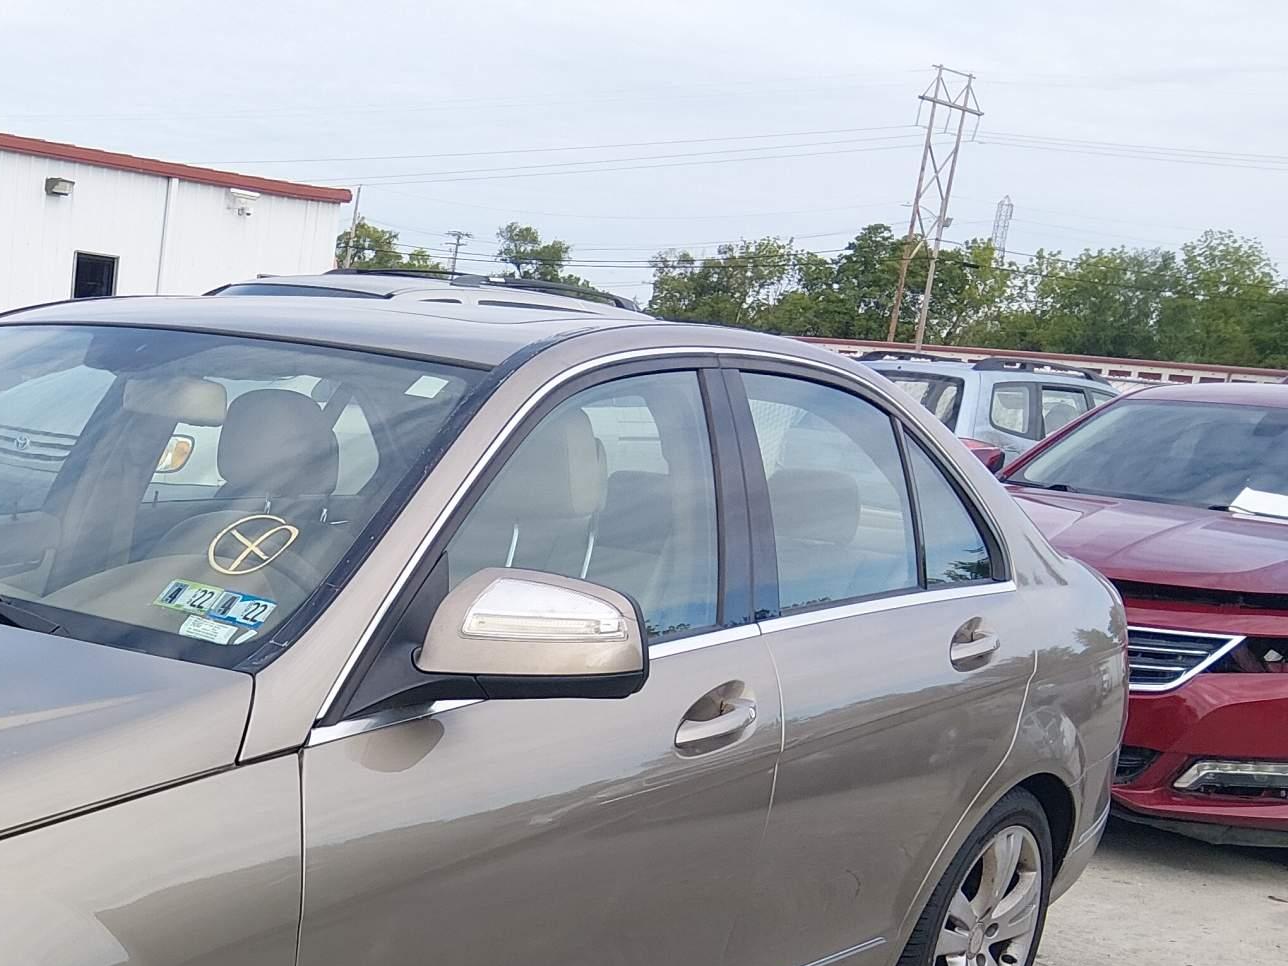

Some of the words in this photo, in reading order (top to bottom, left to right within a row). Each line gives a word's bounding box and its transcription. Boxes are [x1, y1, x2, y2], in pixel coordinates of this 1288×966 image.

[166, 587, 182, 604] 4
[190, 590, 214, 608] 22
[243, 602, 268, 622] 22
